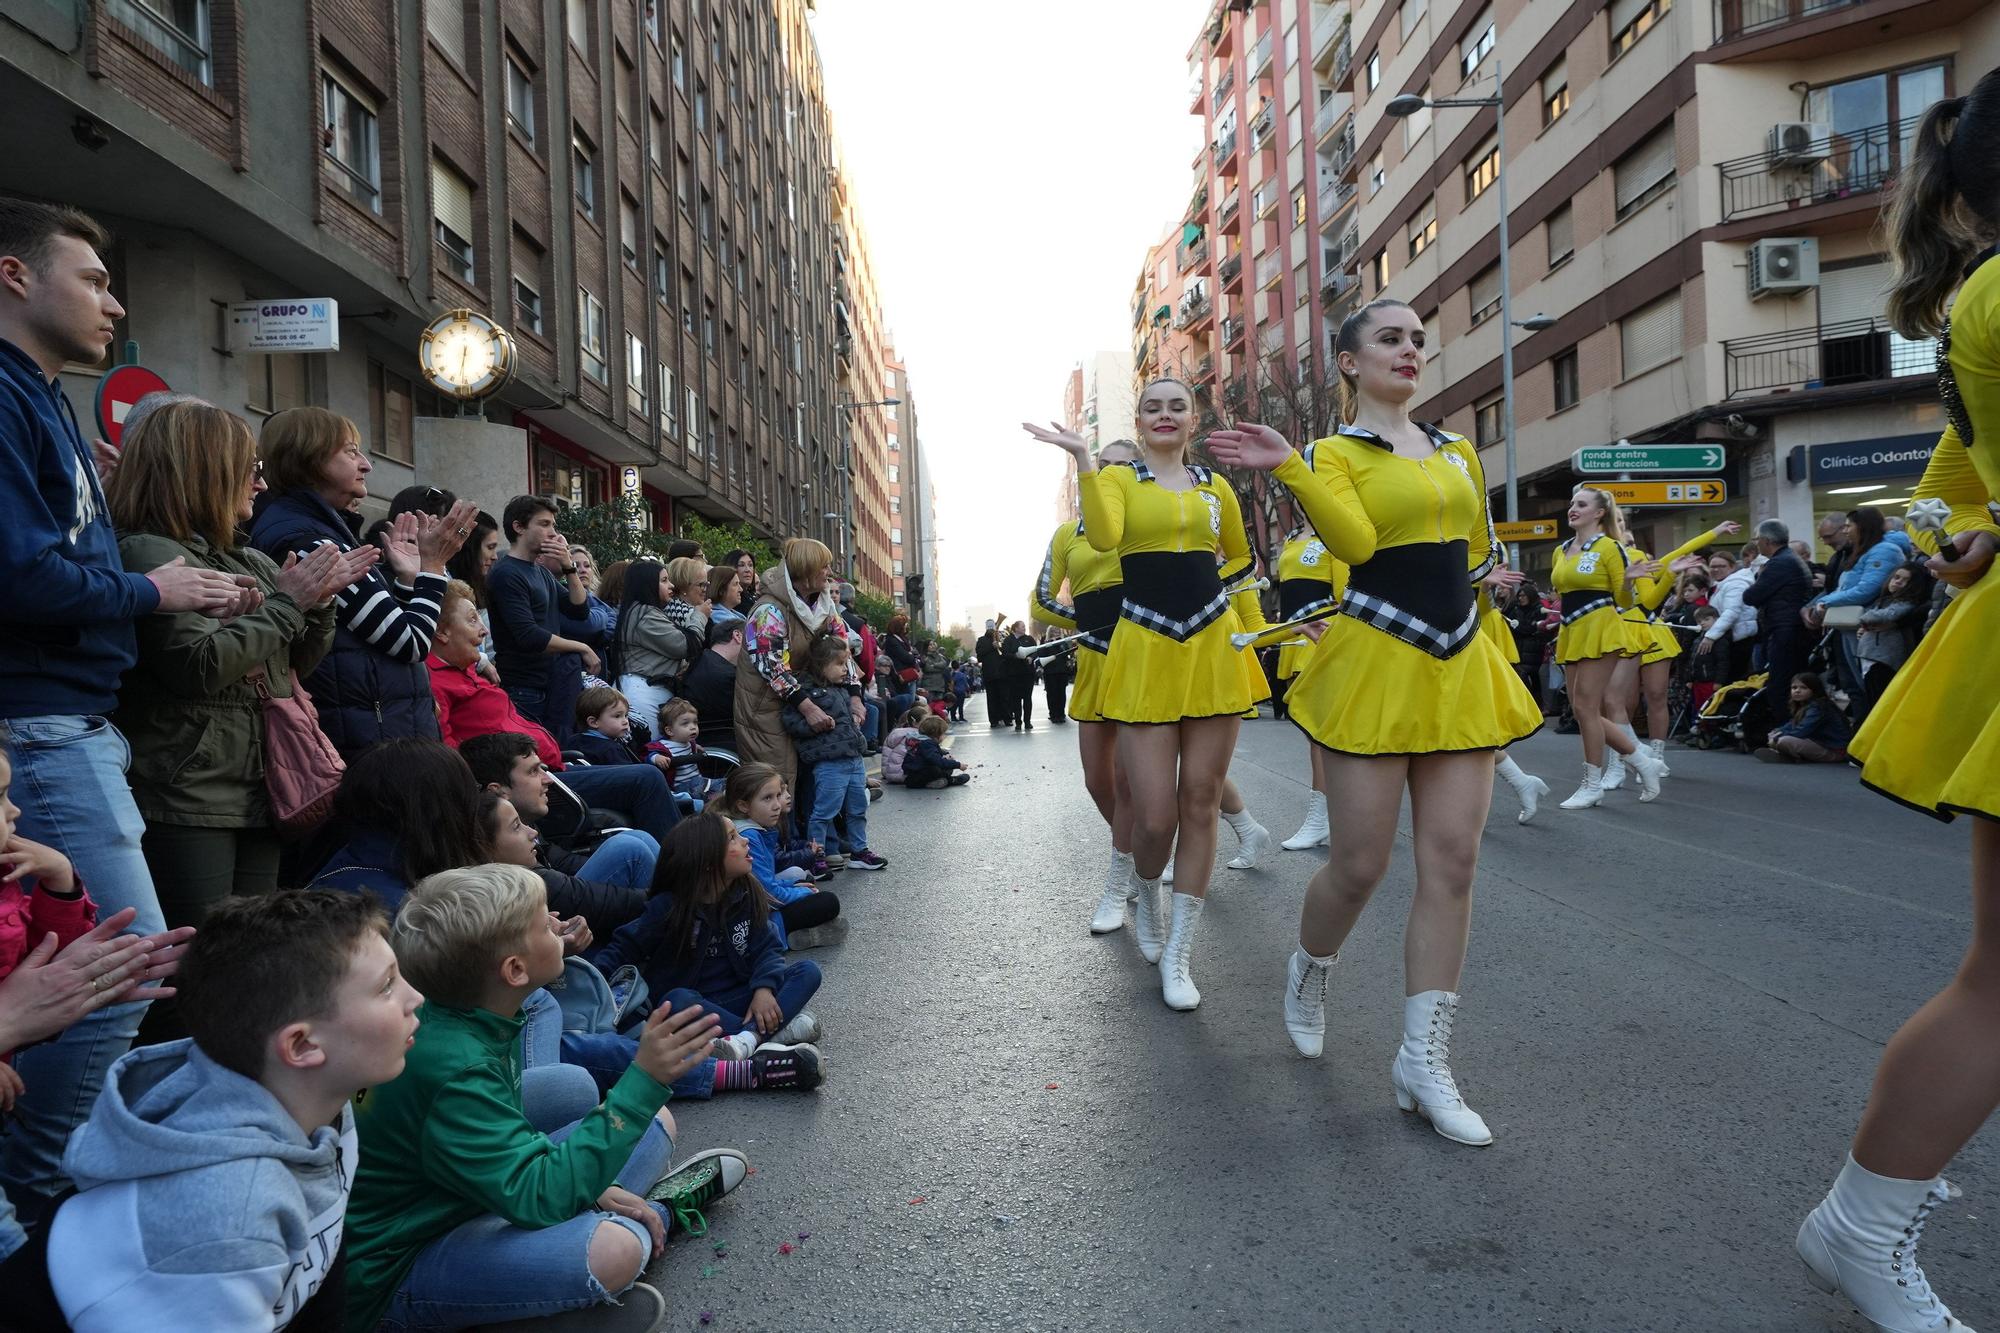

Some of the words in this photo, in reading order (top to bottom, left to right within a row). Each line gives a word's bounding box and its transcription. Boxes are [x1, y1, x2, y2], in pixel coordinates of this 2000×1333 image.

[262, 305, 308, 317] GRUPO
[1583, 451, 1612, 459] ronda
[1615, 450, 1648, 458] centre
[1584, 460, 1611, 468] altres
[1613, 460, 1660, 468] direccions
[1820, 455, 1868, 469] Clínica
[1302, 553, 1316, 563] 66
[1579, 563, 1592, 572] 66
